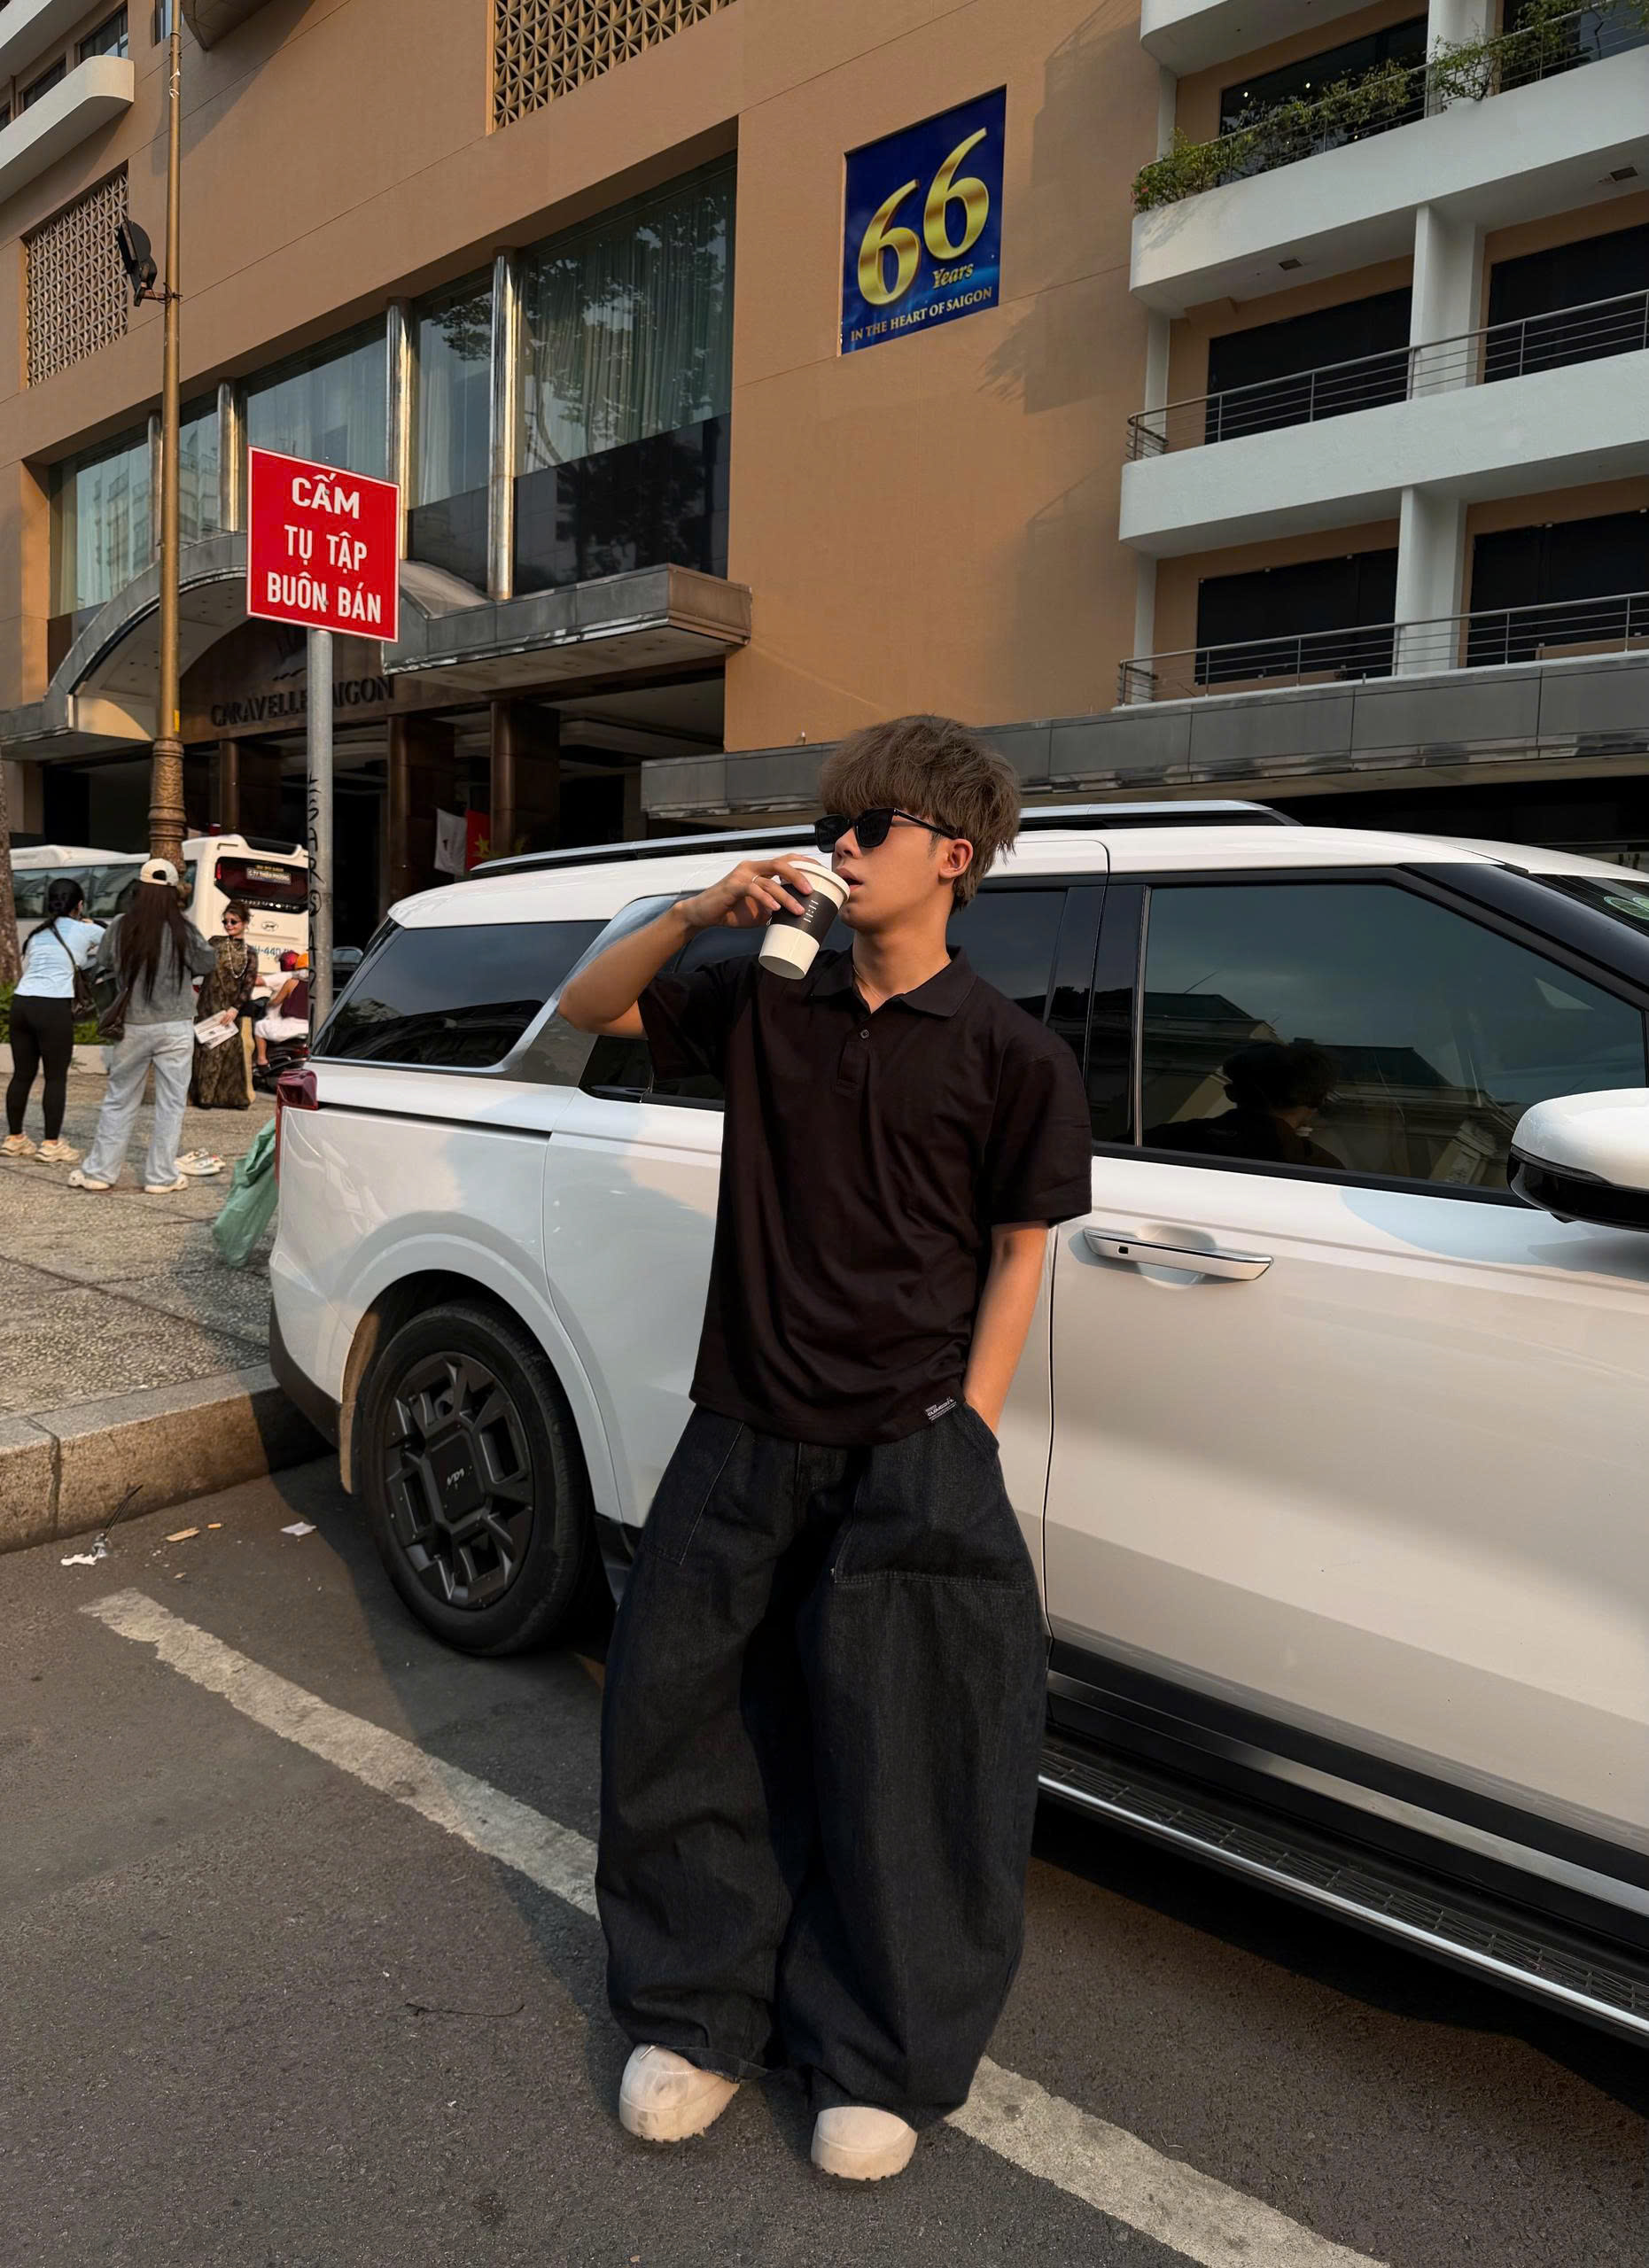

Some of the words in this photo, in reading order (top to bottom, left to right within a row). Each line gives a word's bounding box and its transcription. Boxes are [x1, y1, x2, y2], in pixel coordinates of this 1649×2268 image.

[858, 127, 990, 306] 66
[932, 263, 974, 290] Years
[851, 328, 863, 341] IN
[866, 321, 887, 337] THE
[890, 308, 928, 330] HEART
[929, 305, 945, 317] OF
[945, 287, 992, 312] SAIGON
[292, 472, 360, 520] CẤM
[284, 524, 313, 566] TỤ
[325, 531, 368, 574] TẬP
[267, 571, 327, 613] BUÔN
[338, 581, 382, 625] BÁN
[803, 899, 820, 923] 11:11
